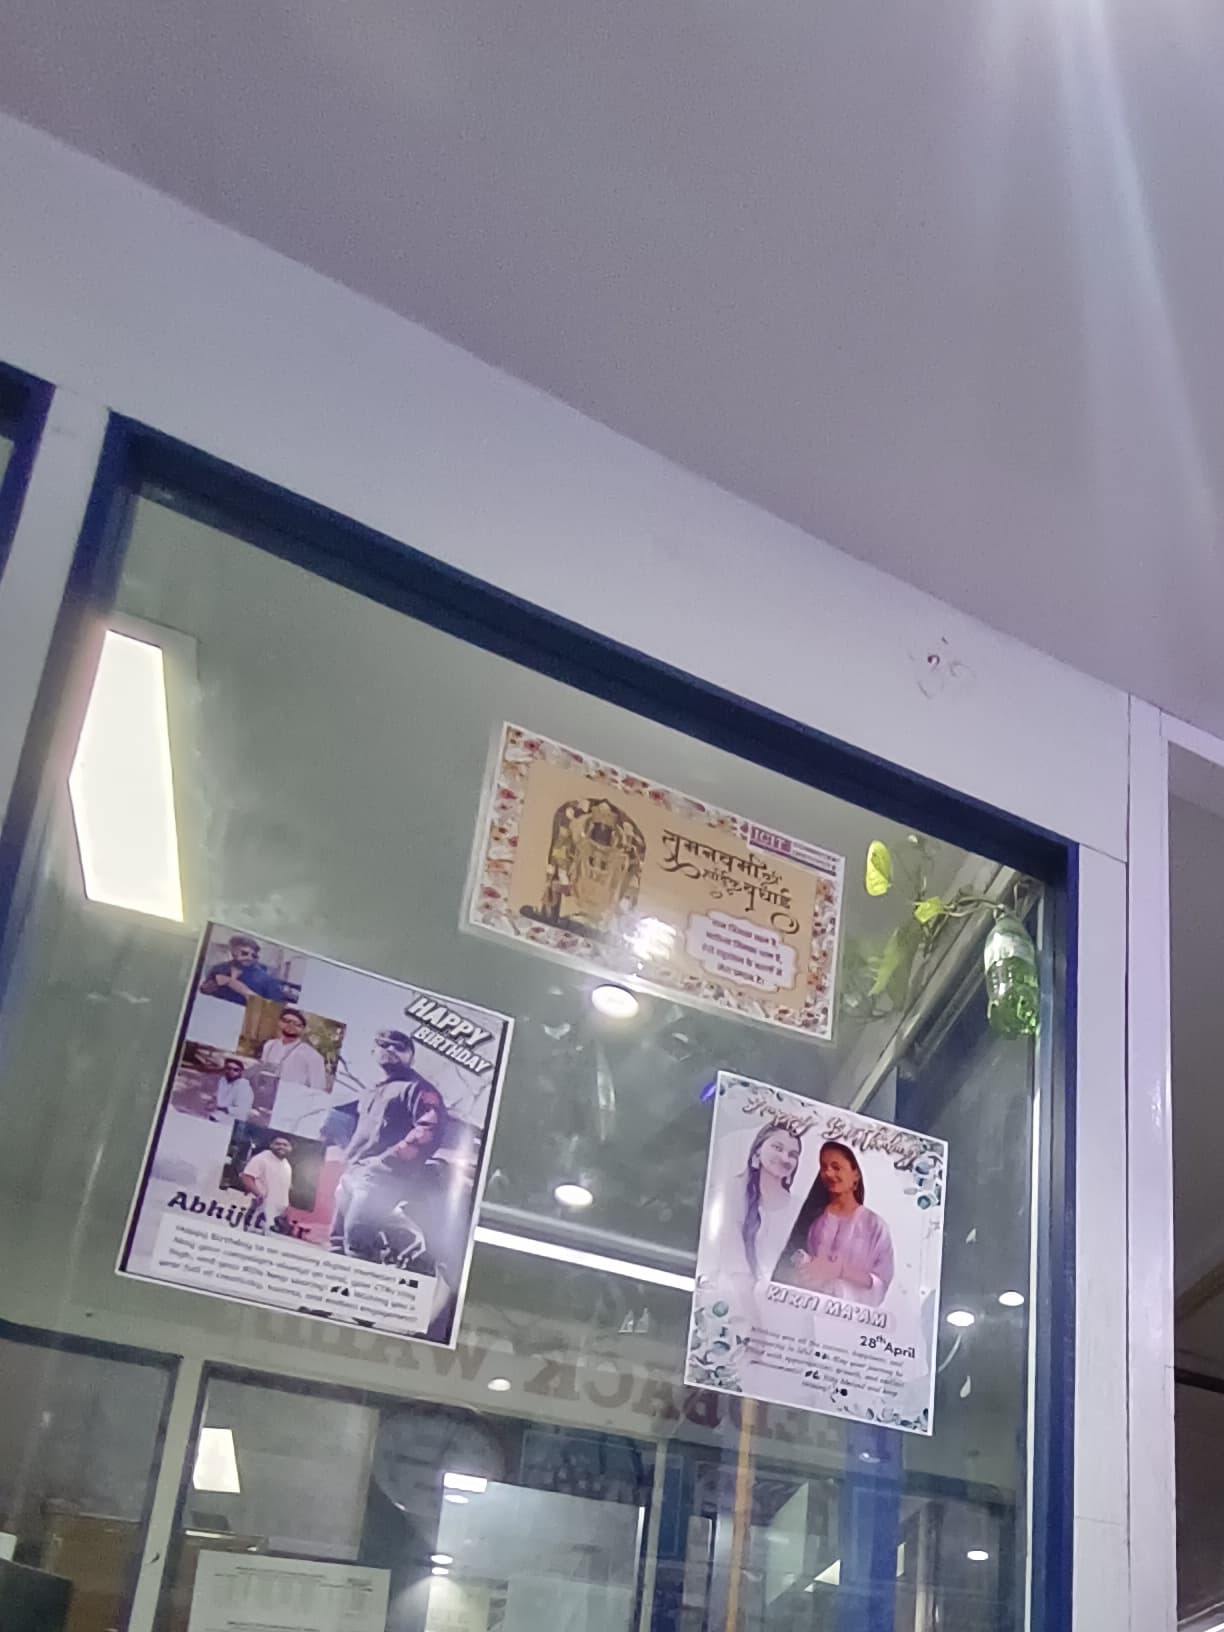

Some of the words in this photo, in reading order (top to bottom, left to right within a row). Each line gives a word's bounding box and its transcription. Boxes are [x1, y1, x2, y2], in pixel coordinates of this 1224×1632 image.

[407, 997, 492, 1047] HAPPY
[413, 1026, 492, 1074] BIRTHDAY
[167, 1190, 267, 1234] Abhijit
[269, 1215, 312, 1241] Sir
[825, 1299, 888, 1329] MA'AM
[884, 1341, 916, 1360] April
